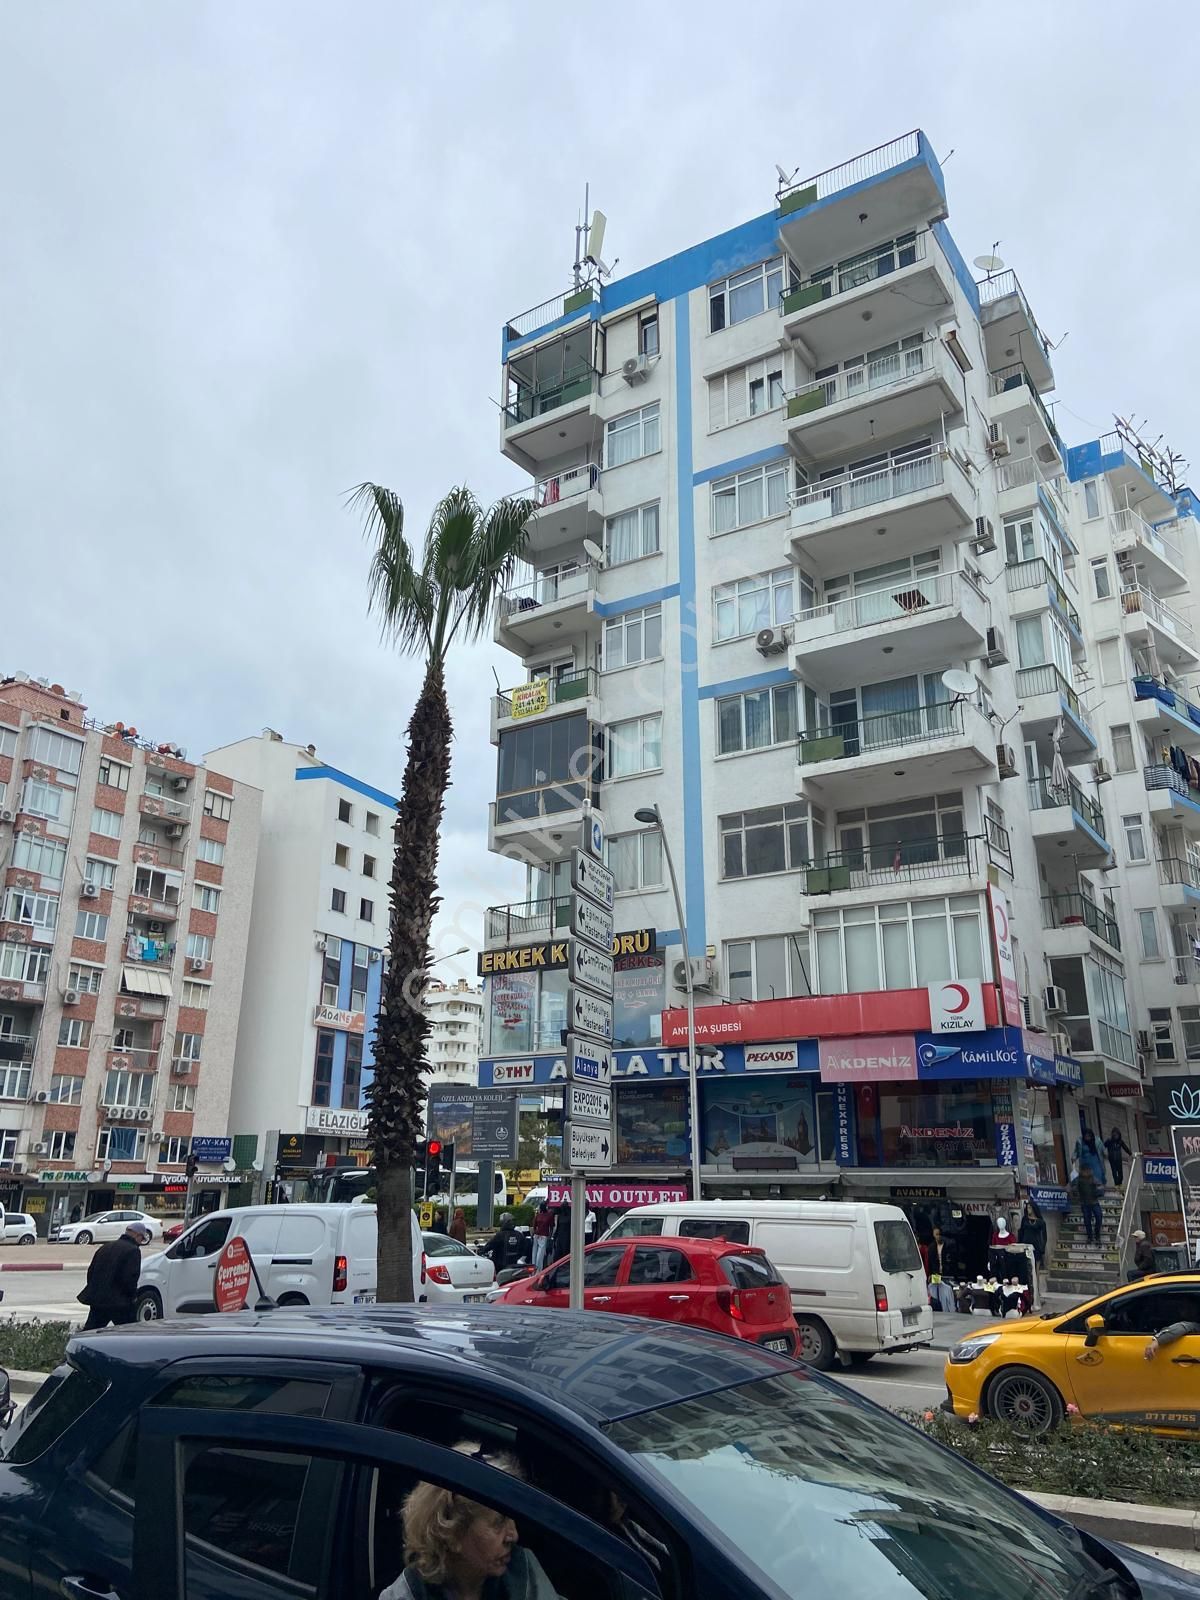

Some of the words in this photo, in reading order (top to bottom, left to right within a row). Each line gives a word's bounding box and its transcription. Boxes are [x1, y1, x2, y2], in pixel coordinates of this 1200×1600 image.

[481, 946, 546, 973] ERKEK
[672, 1025, 709, 1036] ANTLYA
[710, 1021, 742, 1035] ŞUBESİ
[940, 1020, 974, 1030] KIZILAY
[579, 1044, 595, 1058] Aksu
[746, 1050, 795, 1062] PEGASUS
[505, 1064, 533, 1078] THY
[576, 1058, 598, 1076] Alanya
[573, 1091, 602, 1107] EXPO2016
[573, 1104, 602, 1116] ANTALYA
[549, 1189, 604, 1203] BAAN
[609, 1190, 684, 1203] OUTLET
[896, 1188, 941, 1197] AVANTAJ
[1037, 1190, 1068, 1200] KONTUR
